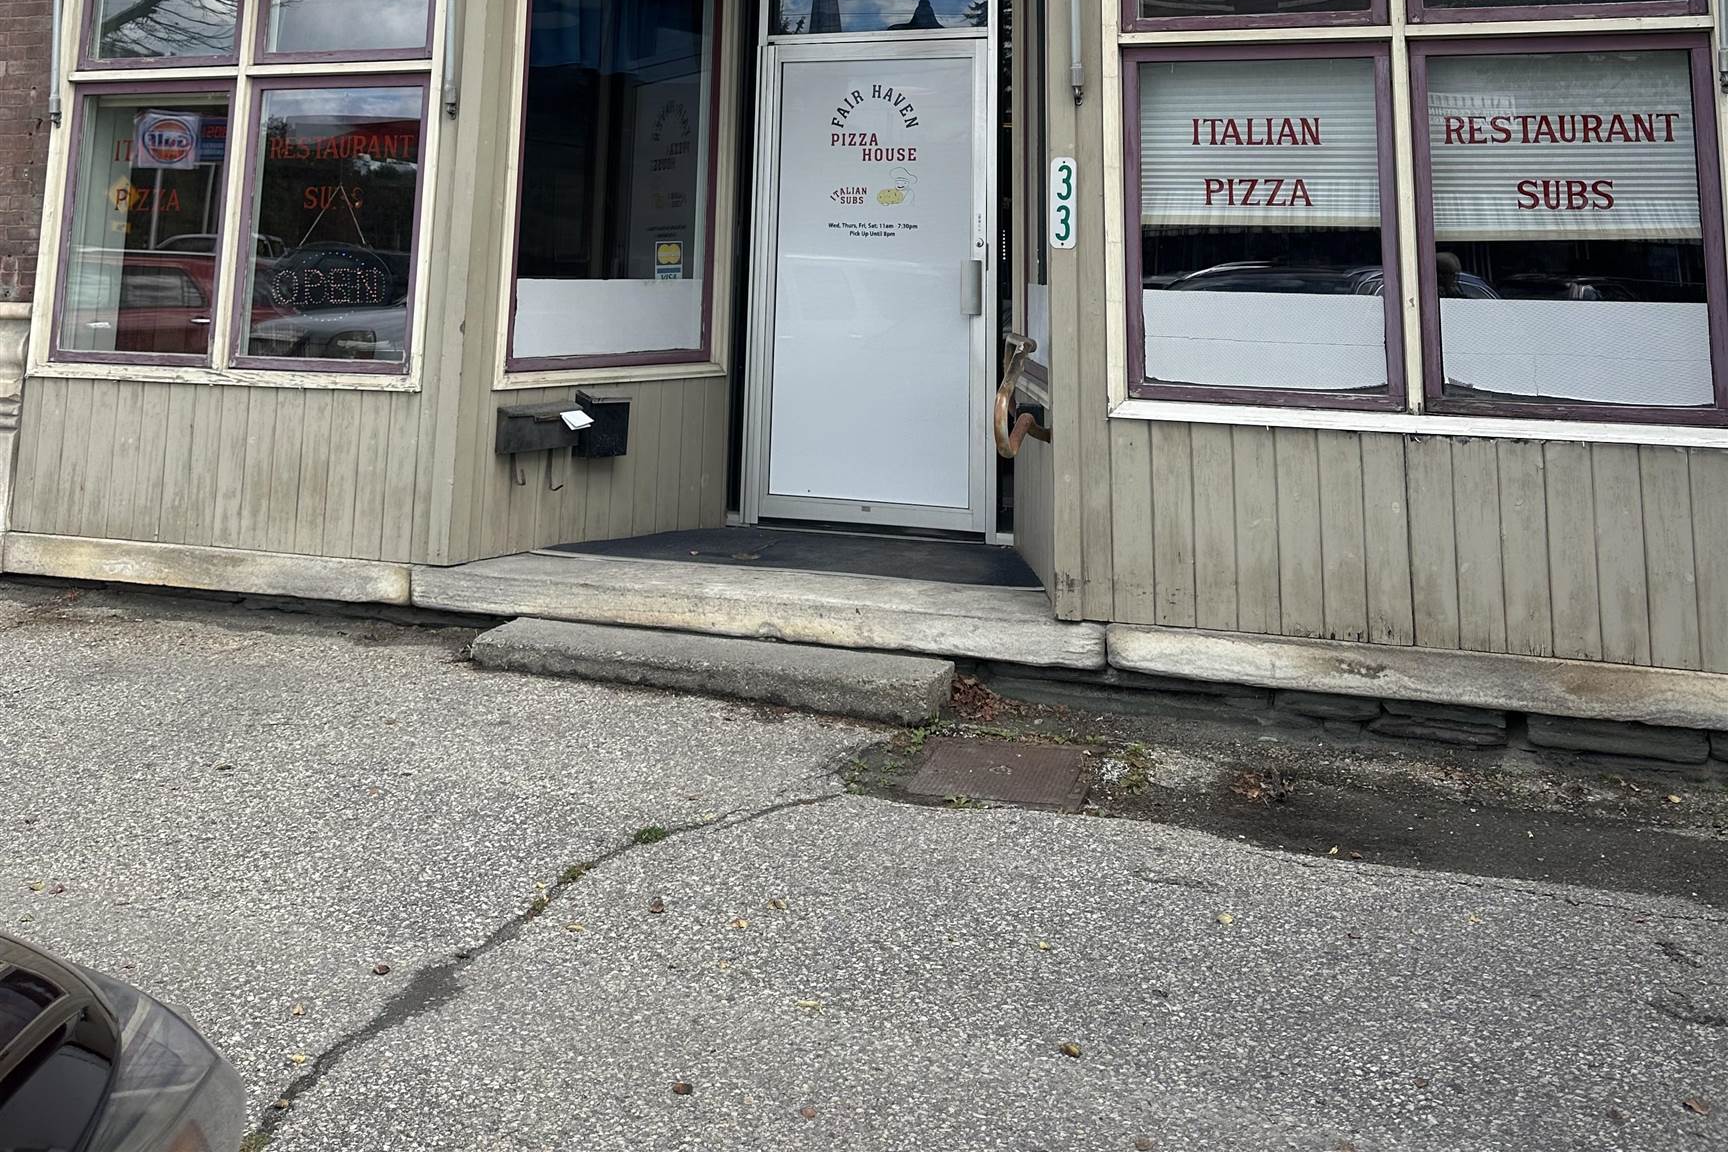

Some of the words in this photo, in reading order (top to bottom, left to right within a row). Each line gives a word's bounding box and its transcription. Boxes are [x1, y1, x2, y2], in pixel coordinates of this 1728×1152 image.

[831, 89, 864, 129] FAIR
[872, 84, 919, 129] HAVEN
[831, 133, 879, 147] PIZZA
[1191, 117, 1322, 146] ITALIAN
[1443, 112, 1681, 145] RESTAURANT
[270, 135, 415, 160] RESTAURANT
[862, 148, 917, 162] HOUSE
[304, 186, 364, 210] SUS
[830, 187, 868, 202] ITALIAN
[840, 196, 864, 205] SUBS
[1203, 178, 1314, 208] PIZZA
[1516, 179, 1615, 211] SUBS
[272, 267, 386, 305] OPEN
